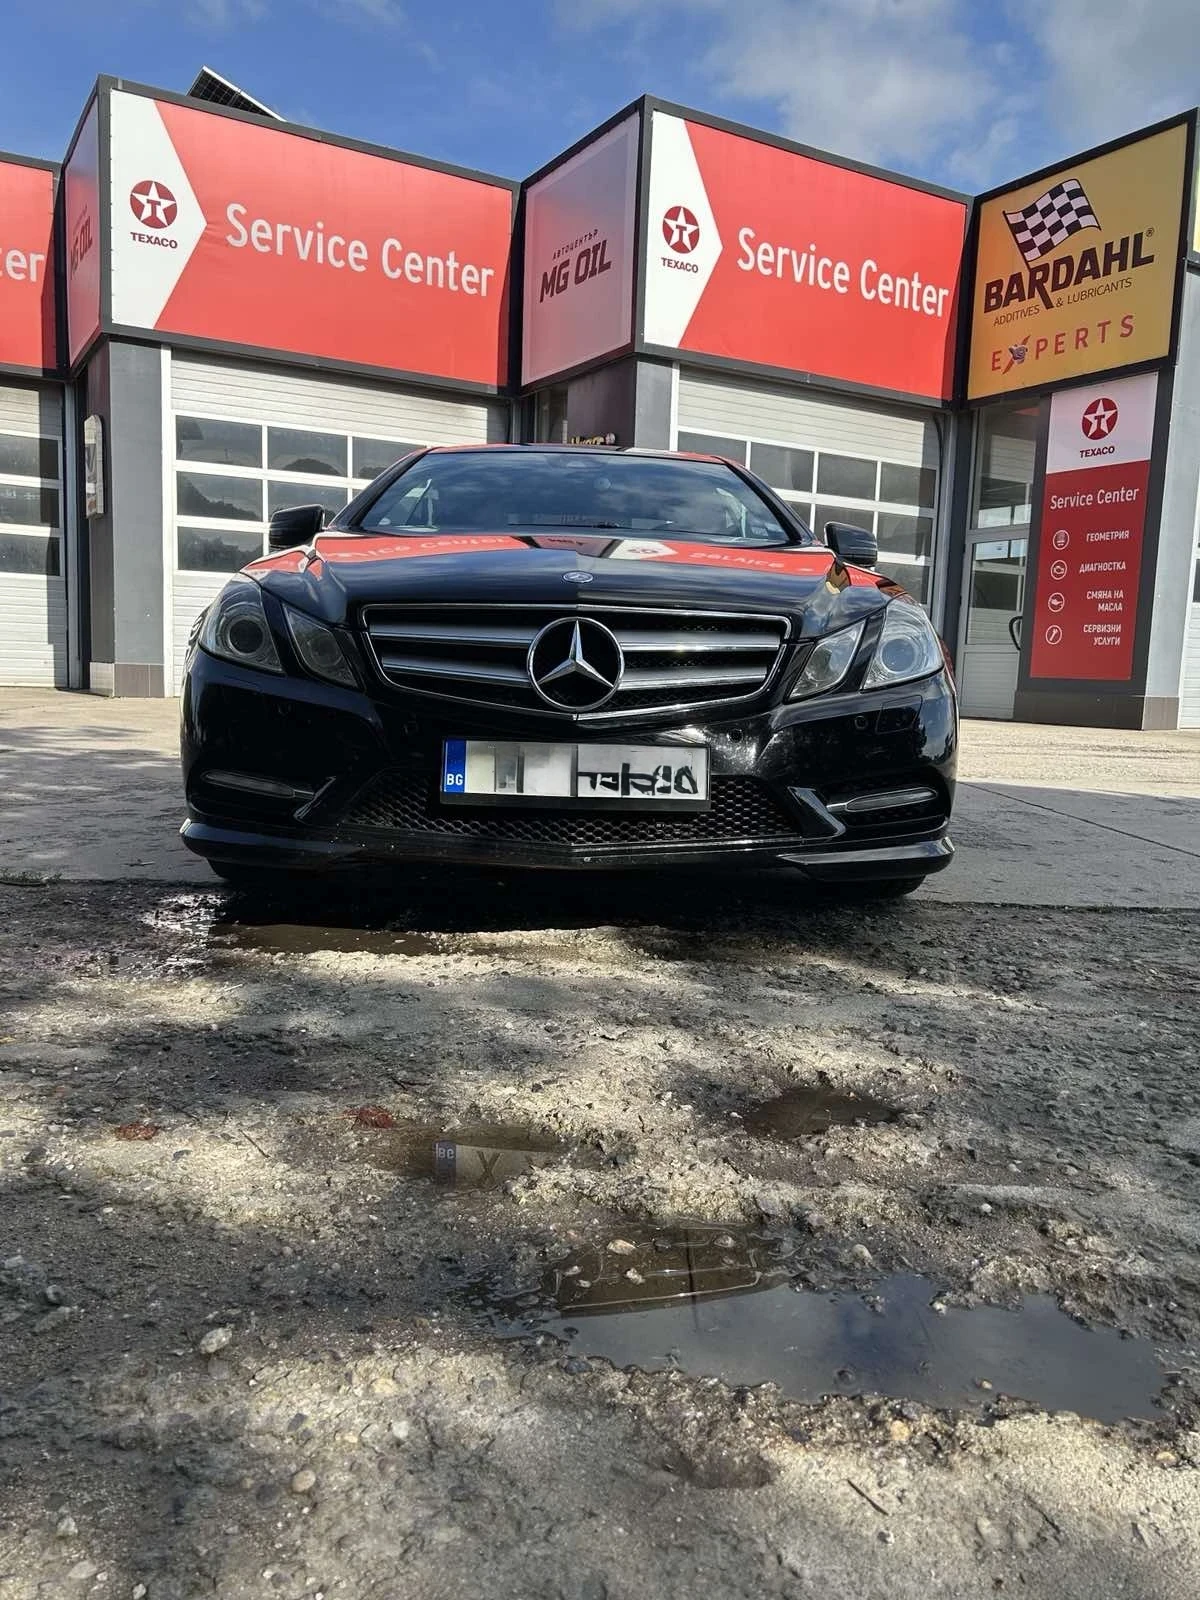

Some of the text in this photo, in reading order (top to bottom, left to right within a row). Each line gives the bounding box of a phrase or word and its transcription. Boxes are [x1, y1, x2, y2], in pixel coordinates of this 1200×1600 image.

[130, 231, 178, 249] TEXACO
[226, 203, 494, 296] Service Center
[0, 247, 45, 282] er
[539, 239, 612, 303] MG OIL
[661, 257, 699, 273] TEXACO
[737, 227, 949, 317] Service Center
[984, 232, 1155, 313] BARDAHL
[993, 277, 1132, 327] ADDITIVES & LUBRICANTS
[1080, 446, 1115, 458] TEXACO
[1050, 487, 1139, 510] Service Center
[1086, 530, 1130, 542] ГЕОМЕТРИЯ
[1086, 590, 1124, 600] СМЯНА НА
[1098, 602, 1123, 612] МАСЛА
[1083, 624, 1121, 633] СЕРВИЗНИ
[1093, 636, 1120, 646] УСЛУГИ
[447, 773, 464, 786] BG
